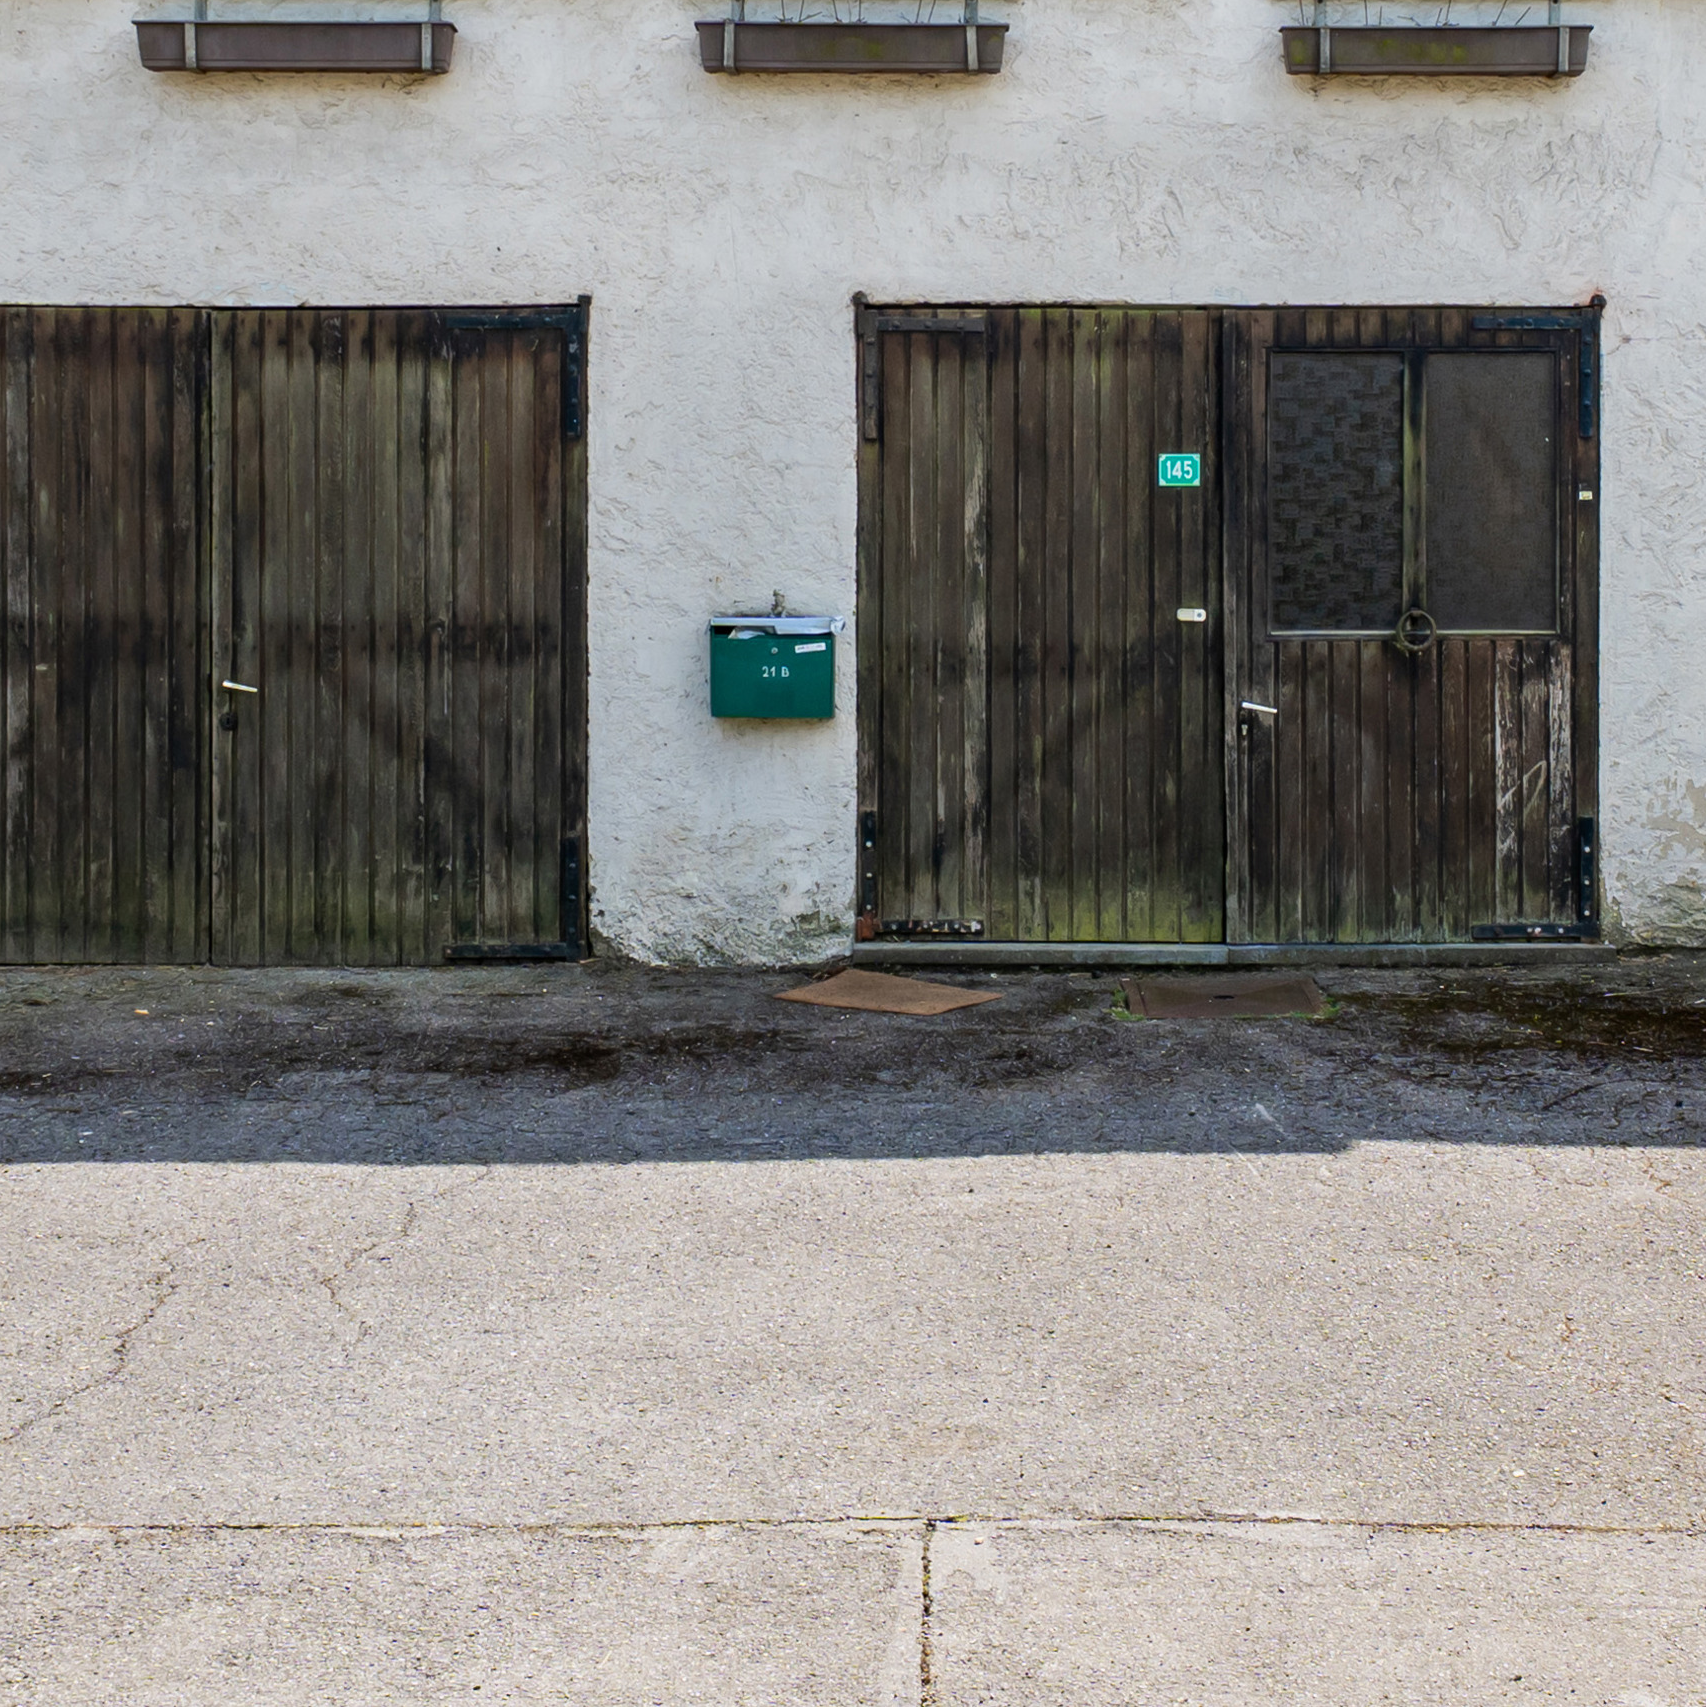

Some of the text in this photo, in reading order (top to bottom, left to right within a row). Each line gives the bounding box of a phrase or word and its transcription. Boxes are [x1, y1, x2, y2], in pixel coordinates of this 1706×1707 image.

[1166, 460, 1193, 479] 145
[762, 666, 789, 677] 21 B
